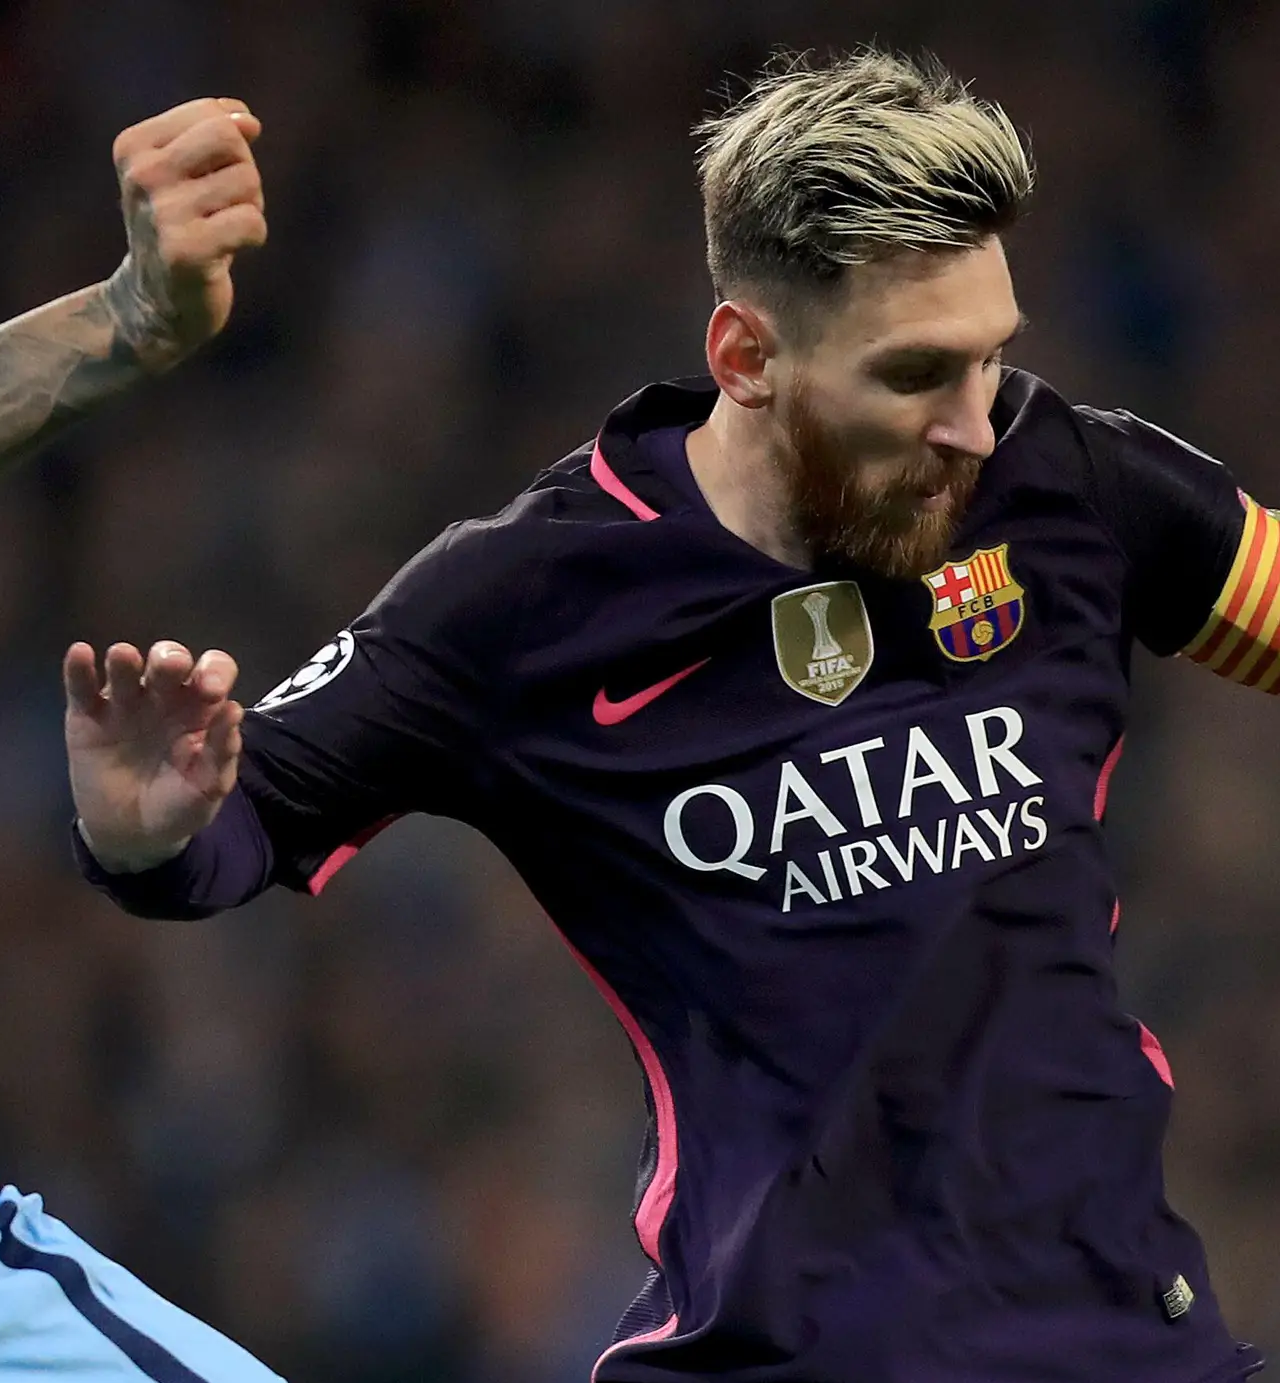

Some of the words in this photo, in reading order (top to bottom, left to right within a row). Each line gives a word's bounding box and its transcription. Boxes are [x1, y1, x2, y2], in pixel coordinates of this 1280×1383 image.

[807, 656, 852, 678] FIFA
[663, 706, 1043, 881] QATAR
[781, 797, 1048, 912] AIRWAYS
